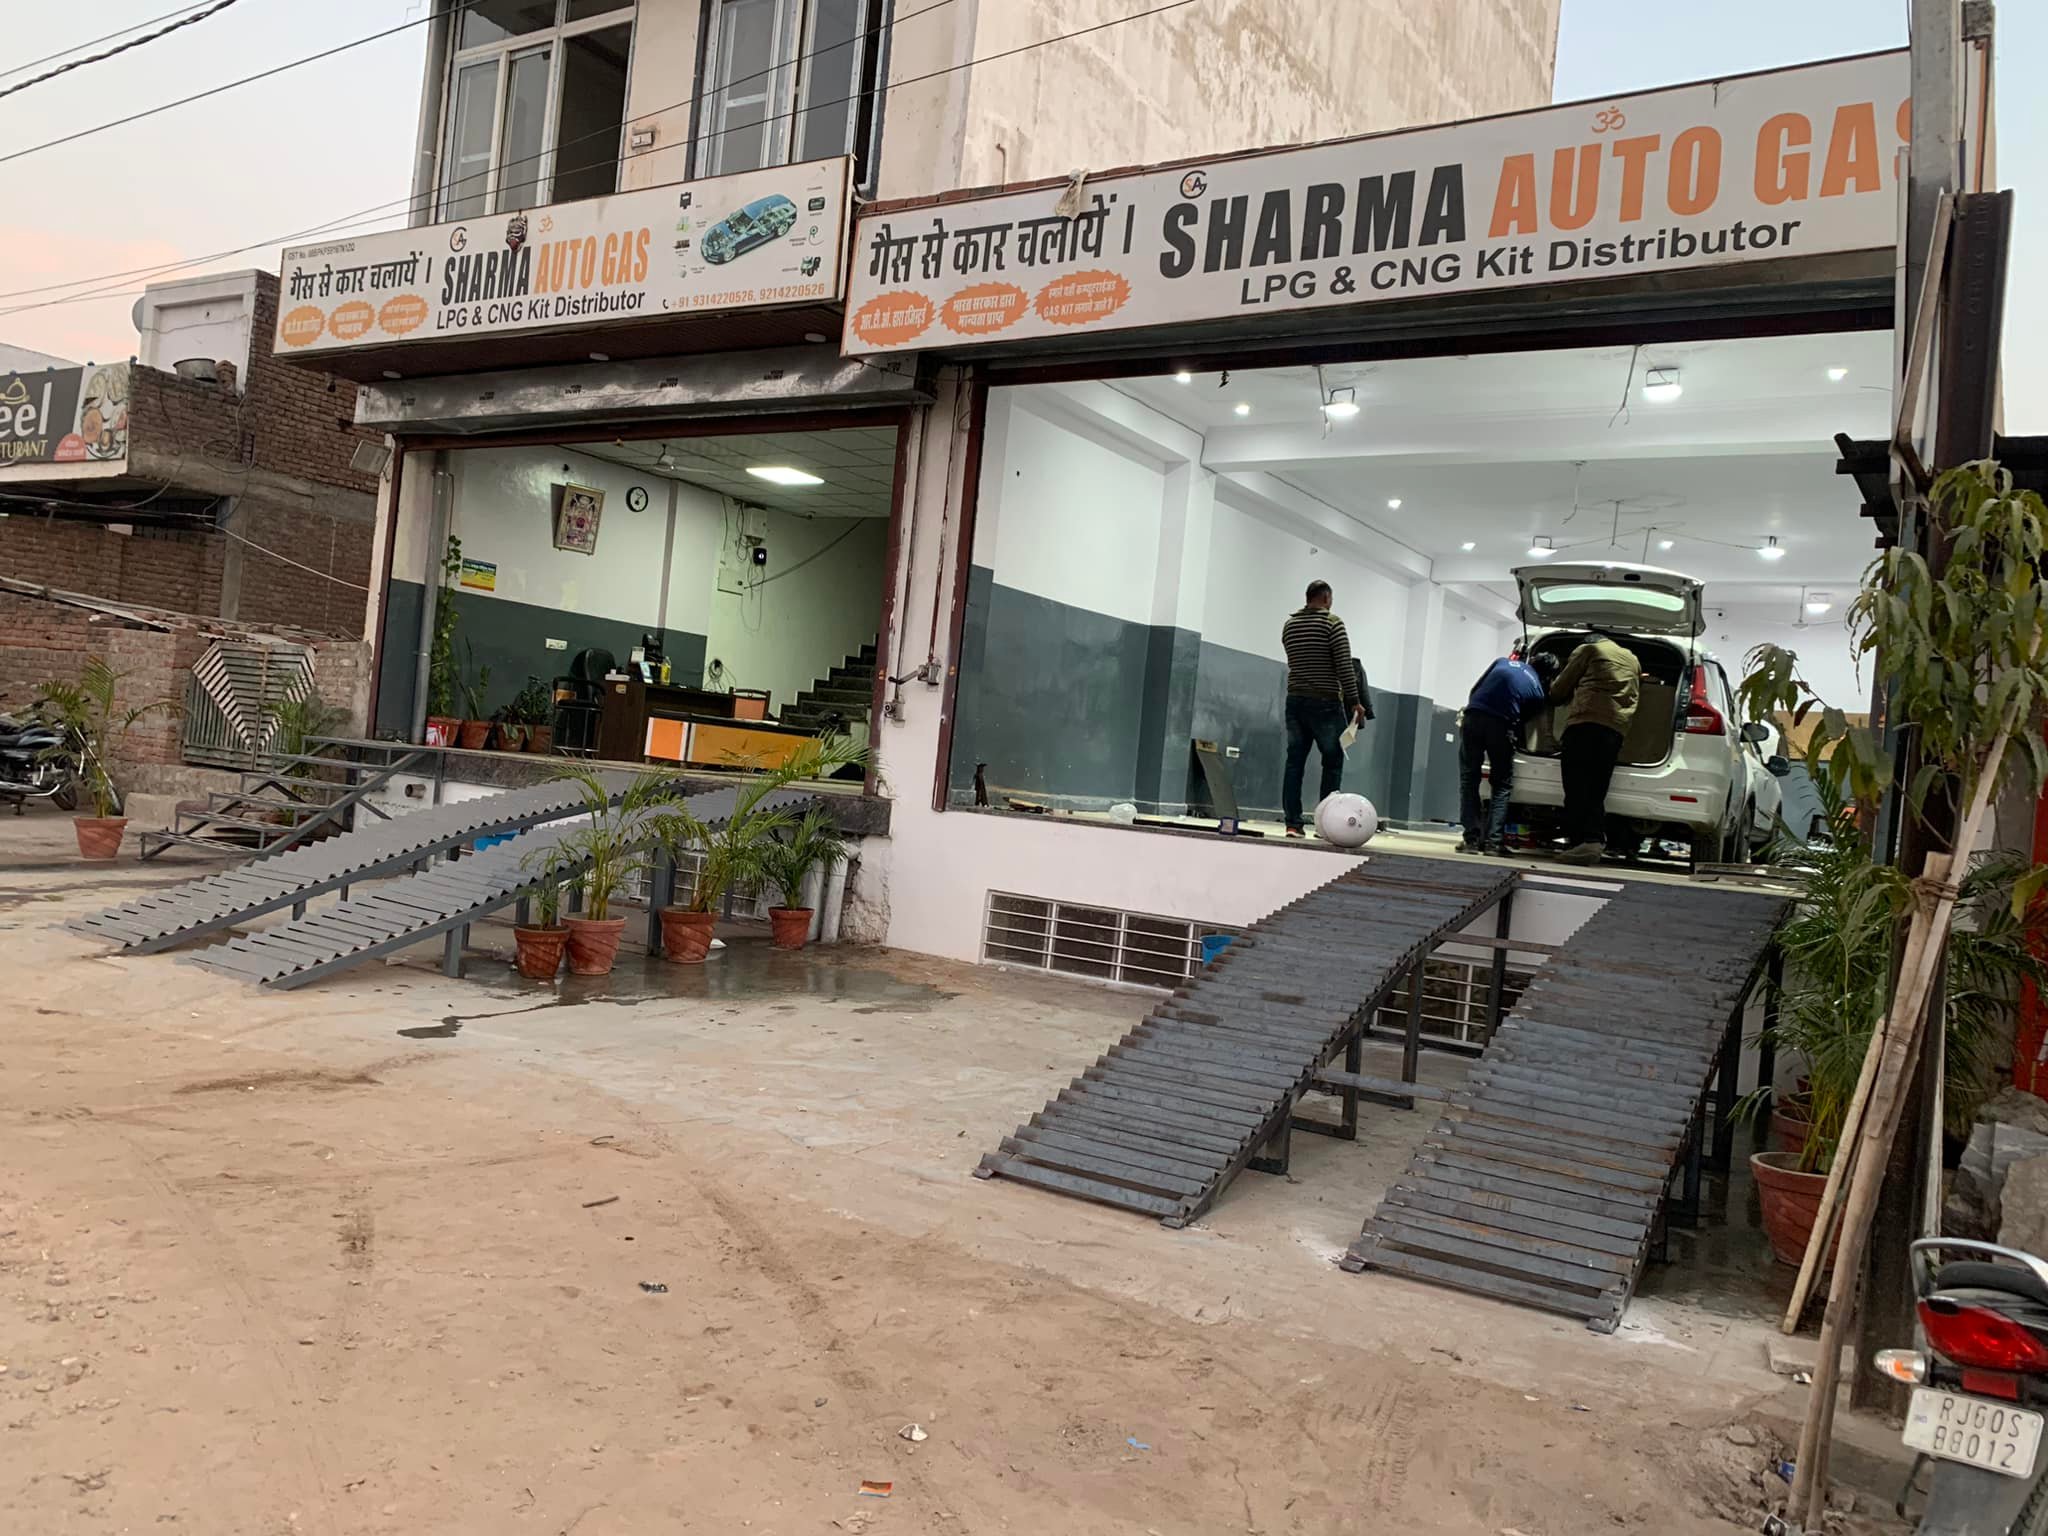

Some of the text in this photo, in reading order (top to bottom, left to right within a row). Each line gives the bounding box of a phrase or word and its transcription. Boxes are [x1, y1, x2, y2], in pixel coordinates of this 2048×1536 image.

[1159, 163, 1466, 279] SHARMA
[1487, 126, 1722, 239] AUTO
[290, 266, 317, 300] गैस
[318, 264, 333, 298] से
[336, 266, 368, 294] कार
[370, 251, 423, 290] चलायें
[442, 227, 650, 306] SHARMA AUTO GAS
[869, 223, 918, 285] गैस
[922, 218, 949, 279] से
[953, 223, 1013, 275] कार
[1240, 217, 1801, 305] LPG & CNG Kit Distributor
[437, 308, 467, 330] LPG
[472, 306, 482, 326] &
[487, 301, 523, 324] CNG
[528, 298, 550, 320] Kit
[554, 289, 645, 317] Distributor
[760, 283, 825, 300] 9214220526
[1043, 304, 1060, 317] GAS
[1061, 303, 1074, 316] KIT
